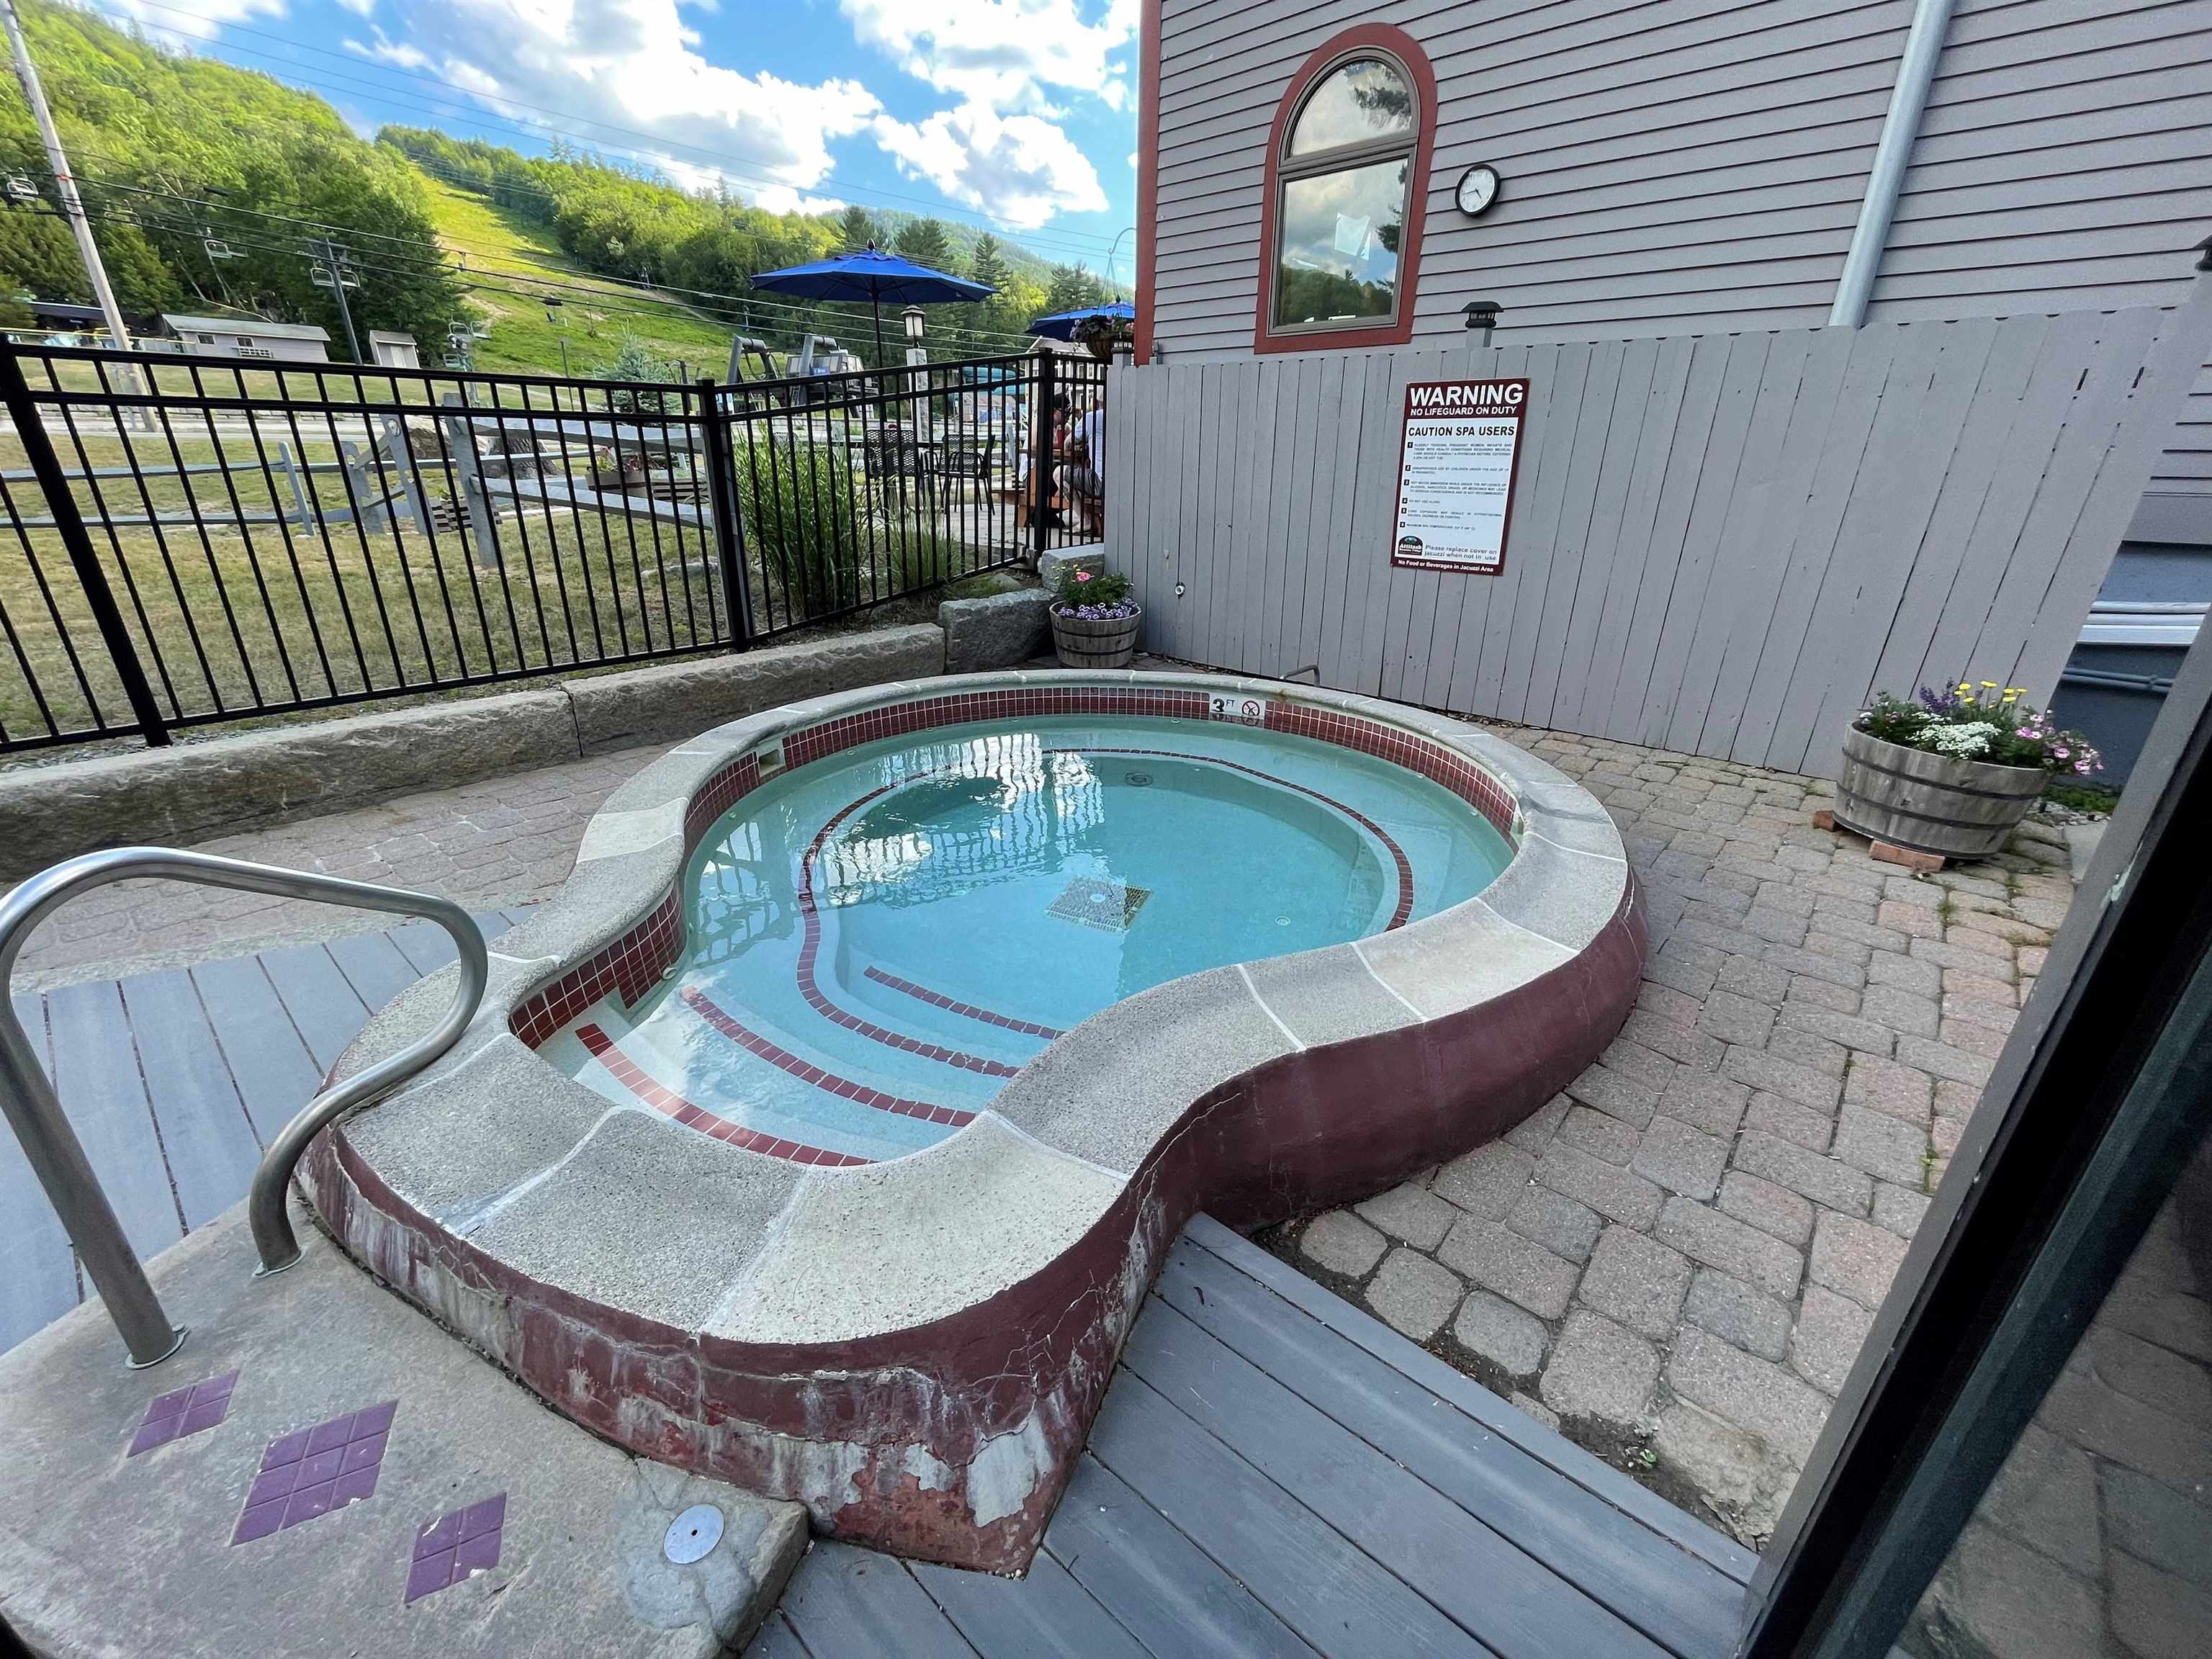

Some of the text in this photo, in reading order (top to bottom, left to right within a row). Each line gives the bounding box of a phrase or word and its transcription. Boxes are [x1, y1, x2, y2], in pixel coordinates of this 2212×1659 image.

[1410, 383, 1524, 406] WARNING
[1424, 407, 1474, 416] LIFEGUARD
[1491, 406, 1517, 415] DUTY
[1408, 426, 1515, 436] CAUTION SPA USERS
[1212, 698, 1225, 713] 3
